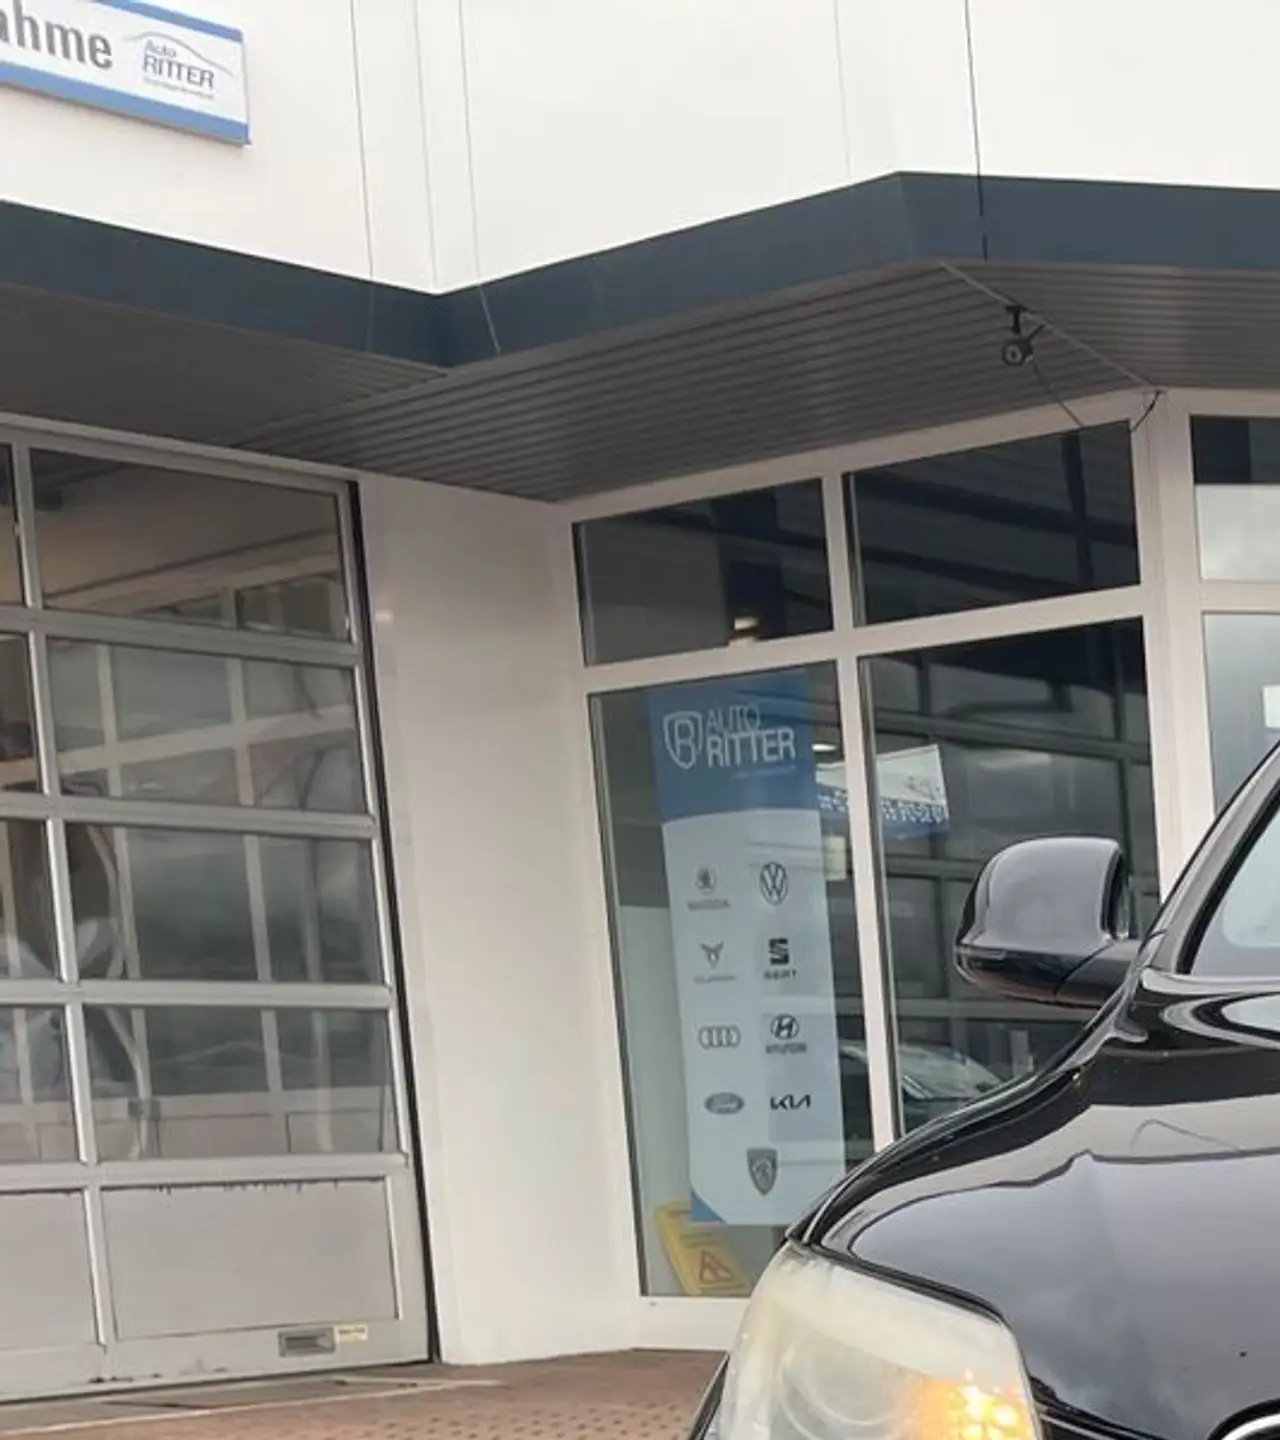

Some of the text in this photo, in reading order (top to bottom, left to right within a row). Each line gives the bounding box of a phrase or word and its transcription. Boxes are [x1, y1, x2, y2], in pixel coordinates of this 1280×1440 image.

[142, 54, 215, 88] RITTER
[706, 703, 761, 733] AUTO
[706, 726, 796, 768] RITTER
